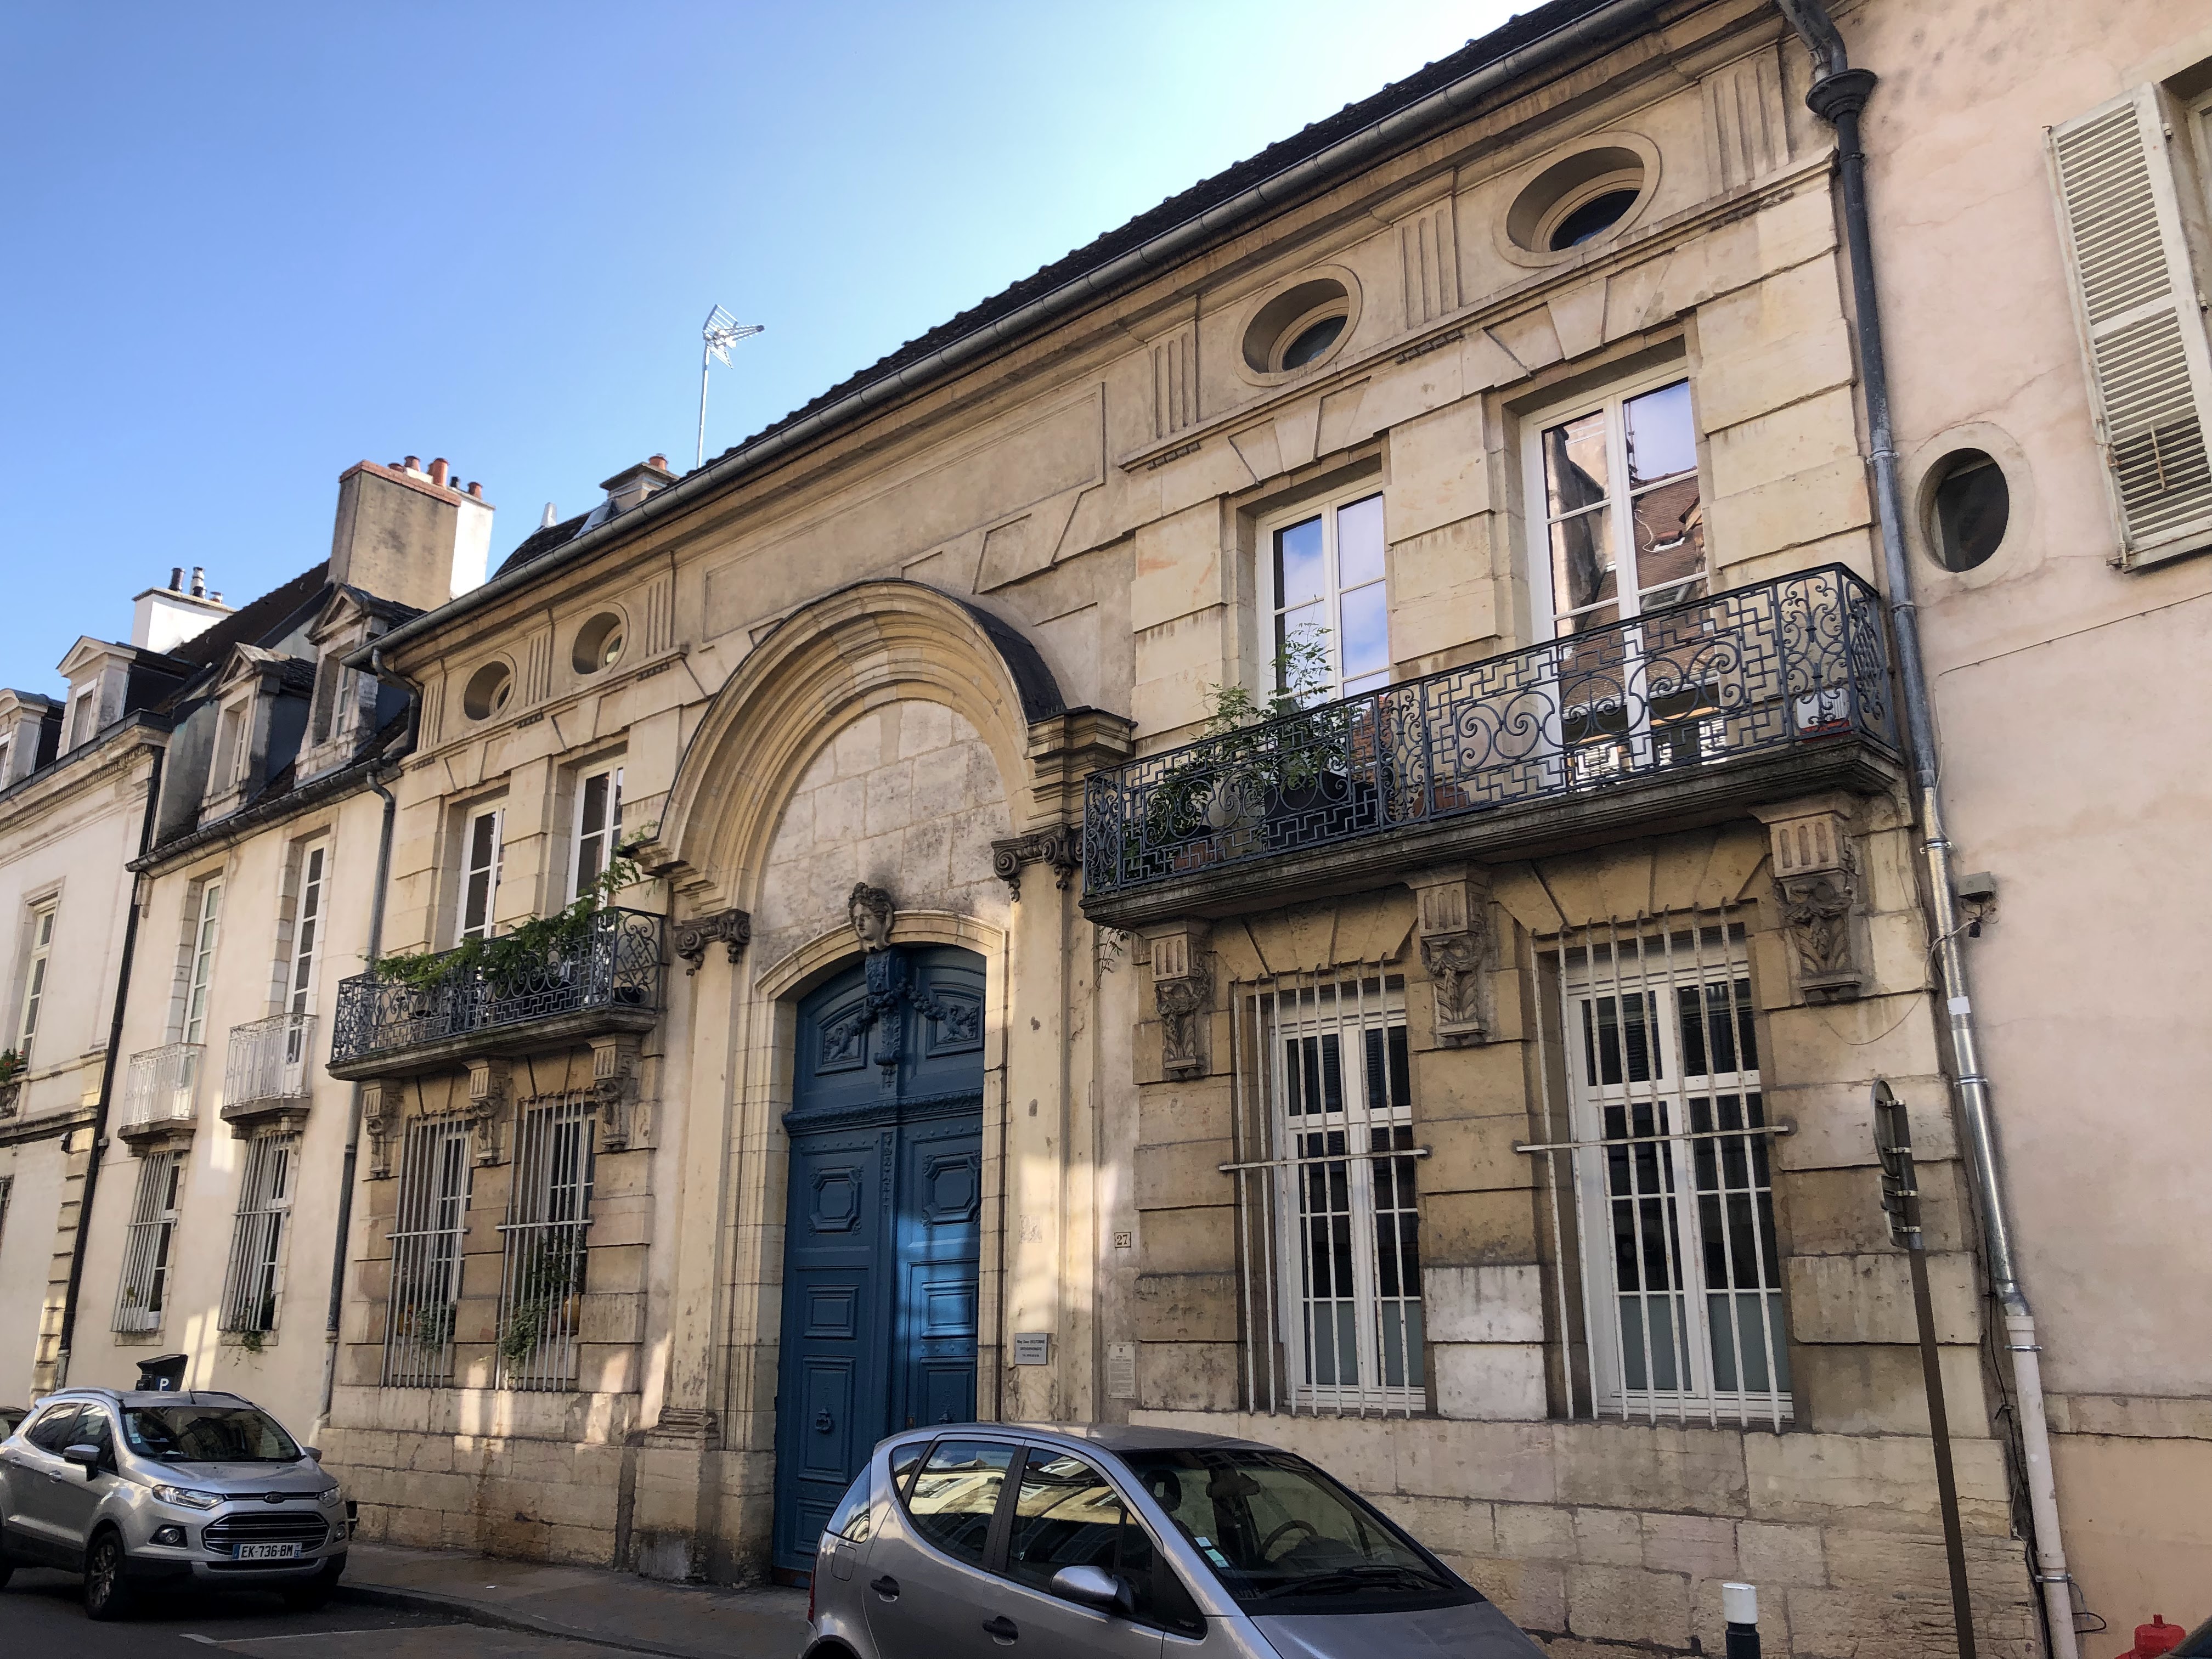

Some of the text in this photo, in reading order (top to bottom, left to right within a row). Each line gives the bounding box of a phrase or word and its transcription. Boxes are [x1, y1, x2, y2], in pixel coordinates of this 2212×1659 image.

[1116, 1234, 1127, 1245] 27
[159, 1378, 170, 1391] P
[241, 1545, 293, 1558] EK-736-BM
